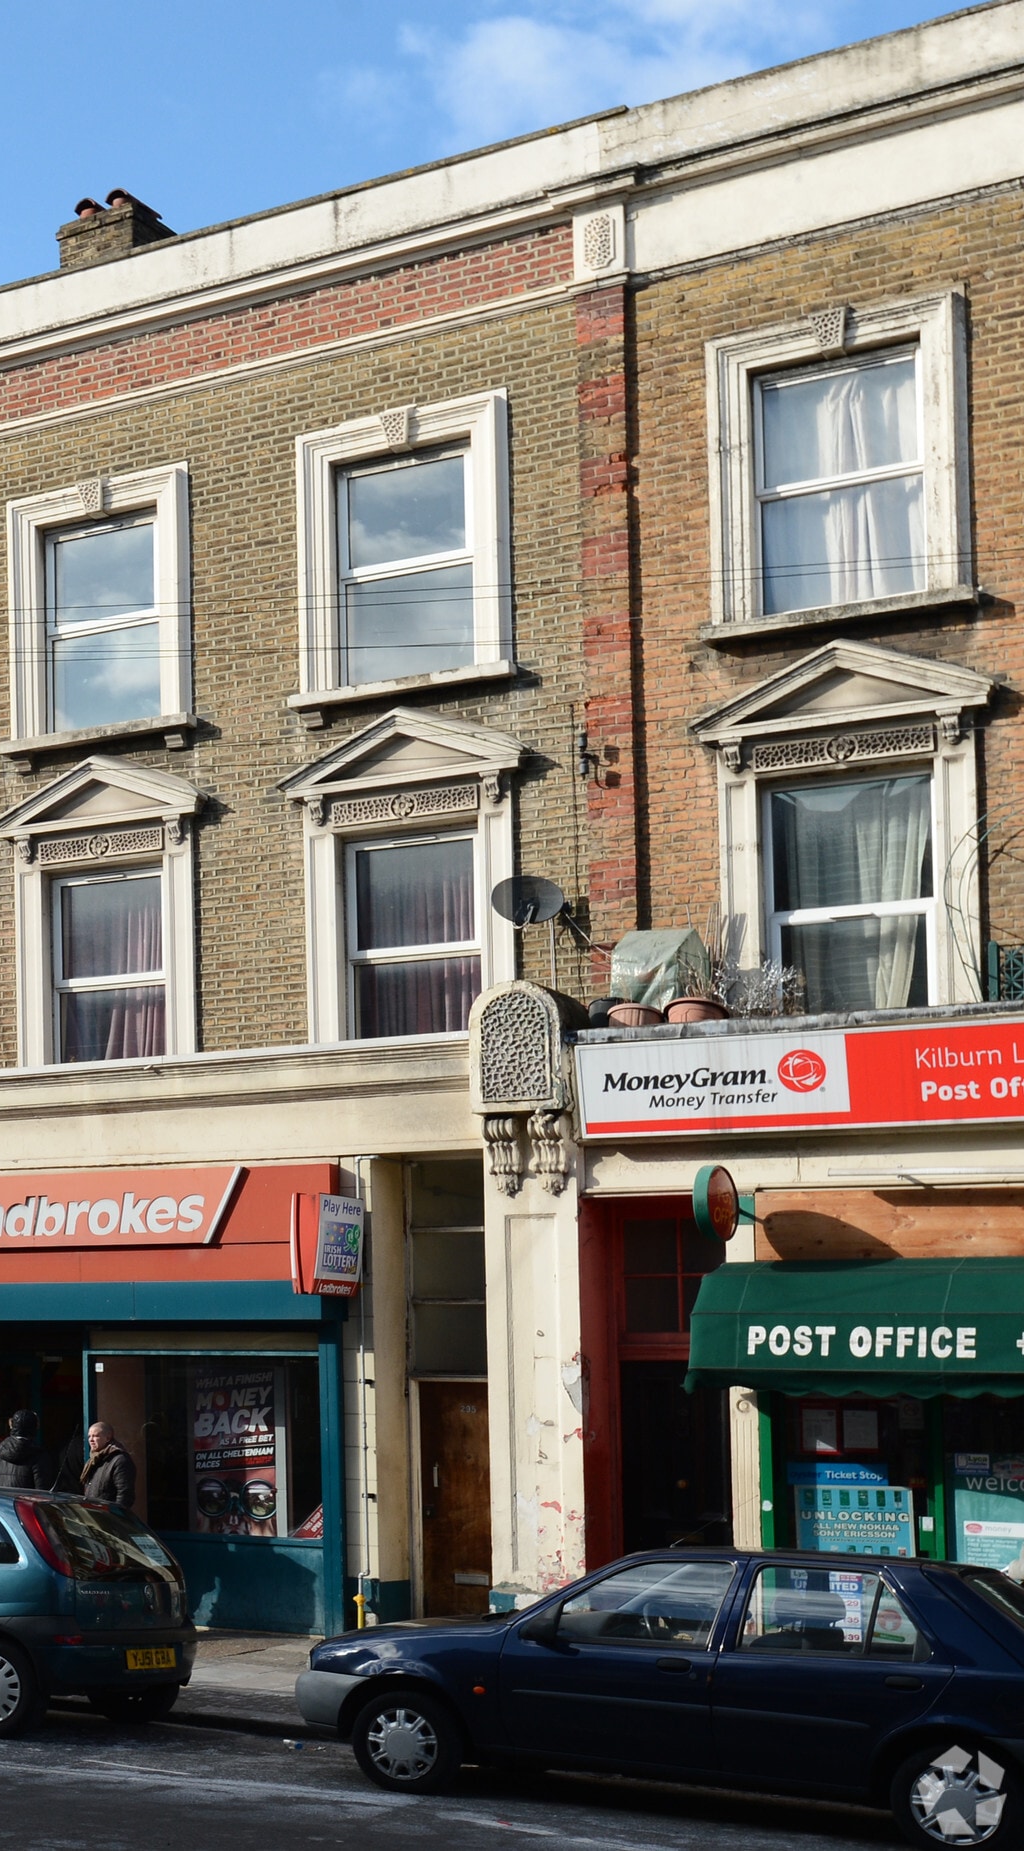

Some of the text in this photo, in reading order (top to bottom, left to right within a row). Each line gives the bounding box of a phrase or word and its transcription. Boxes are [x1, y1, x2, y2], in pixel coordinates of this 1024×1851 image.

[915, 1046, 1002, 1069] Kilburn
[602, 1067, 767, 1094] MoneyGram
[920, 1076, 1024, 1102] Post Of
[648, 1088, 778, 1110] Money Transfer
[322, 1199, 361, 1216] Play Here
[323, 1245, 342, 1254] IRISH
[323, 1253, 357, 1269] LOTTERY
[318, 1283, 352, 1296] Ladbrokes
[747, 1325, 977, 1359] POST OFFICE
[195, 1372, 273, 1389] WHAT A FINISH!
[194, 1406, 272, 1437] BACK
[219, 1434, 274, 1446] AS A FREE BET
[196, 1447, 274, 1461] ON ALL CHELTENHAM
[195, 1460, 220, 1469] RACES
[825, 1470, 857, 1480] Ticket
[859, 1471, 883, 1481] Stop
[801, 1511, 910, 1522] UNLOCKING
[813, 1529, 896, 1538] SONY ERICSSON
